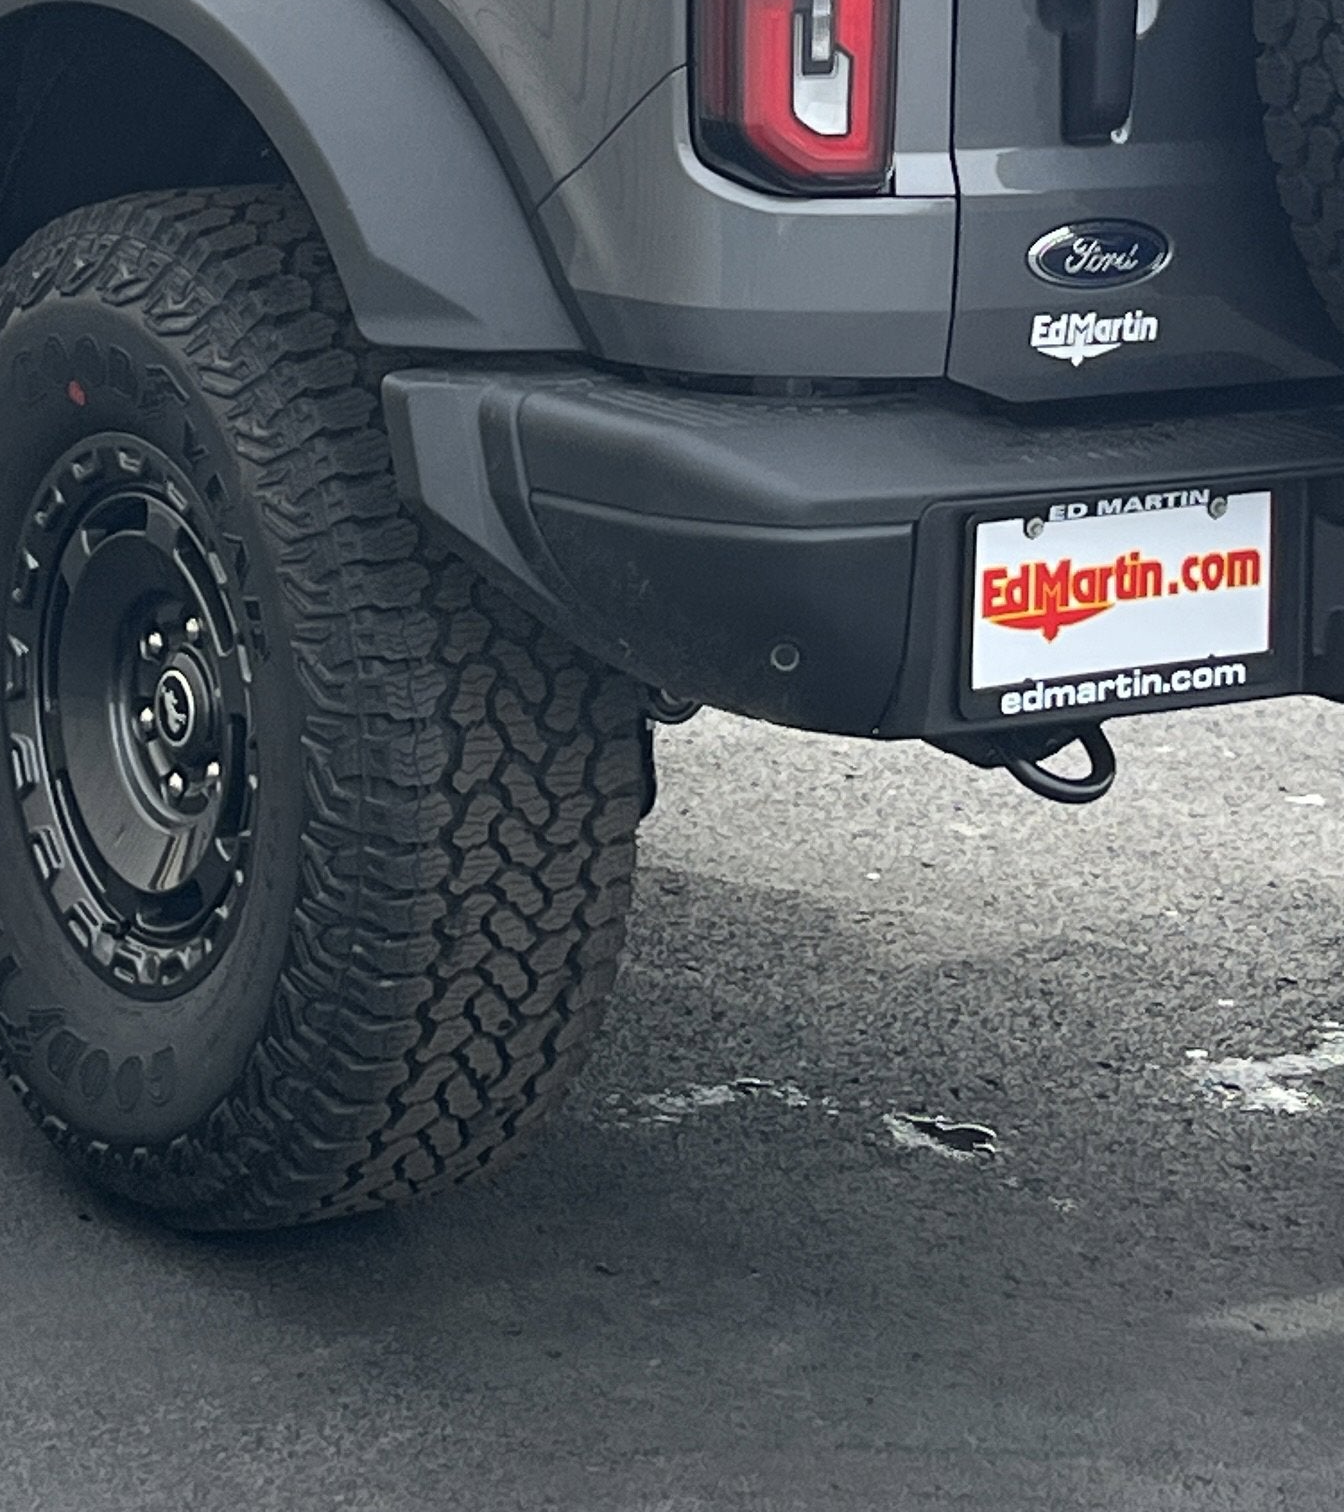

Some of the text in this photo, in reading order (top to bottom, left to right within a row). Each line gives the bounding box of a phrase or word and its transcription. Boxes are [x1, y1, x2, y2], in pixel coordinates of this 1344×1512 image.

[1064, 238, 1139, 274] Ford
[1029, 308, 1159, 349] EdMartin
[1050, 489, 1211, 522] ED MARTIN
[1001, 660, 1247, 716] edmartin.com
